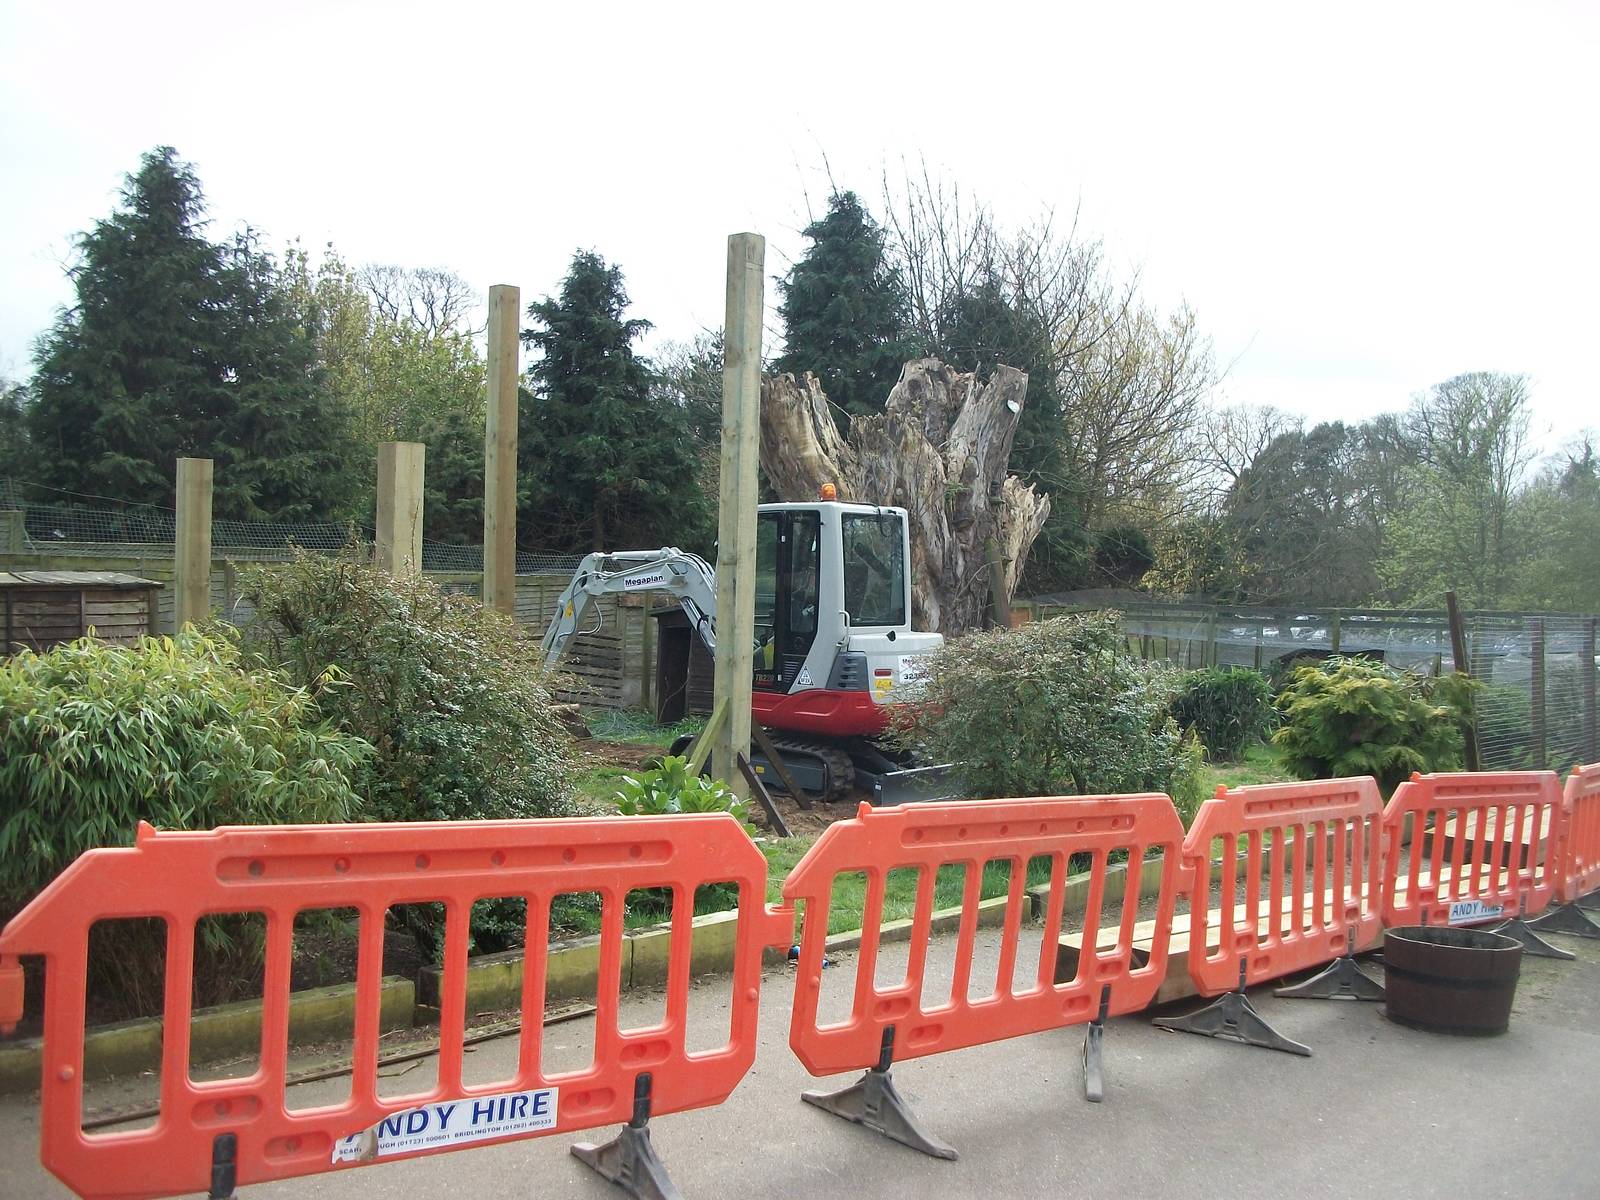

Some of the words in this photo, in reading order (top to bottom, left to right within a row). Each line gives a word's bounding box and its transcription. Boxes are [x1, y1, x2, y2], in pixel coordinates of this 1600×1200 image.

[1452, 902, 1479, 916] ANDY
[472, 1091, 550, 1124] HIRE
[454, 1126, 501, 1138] BRIDLINGTON
